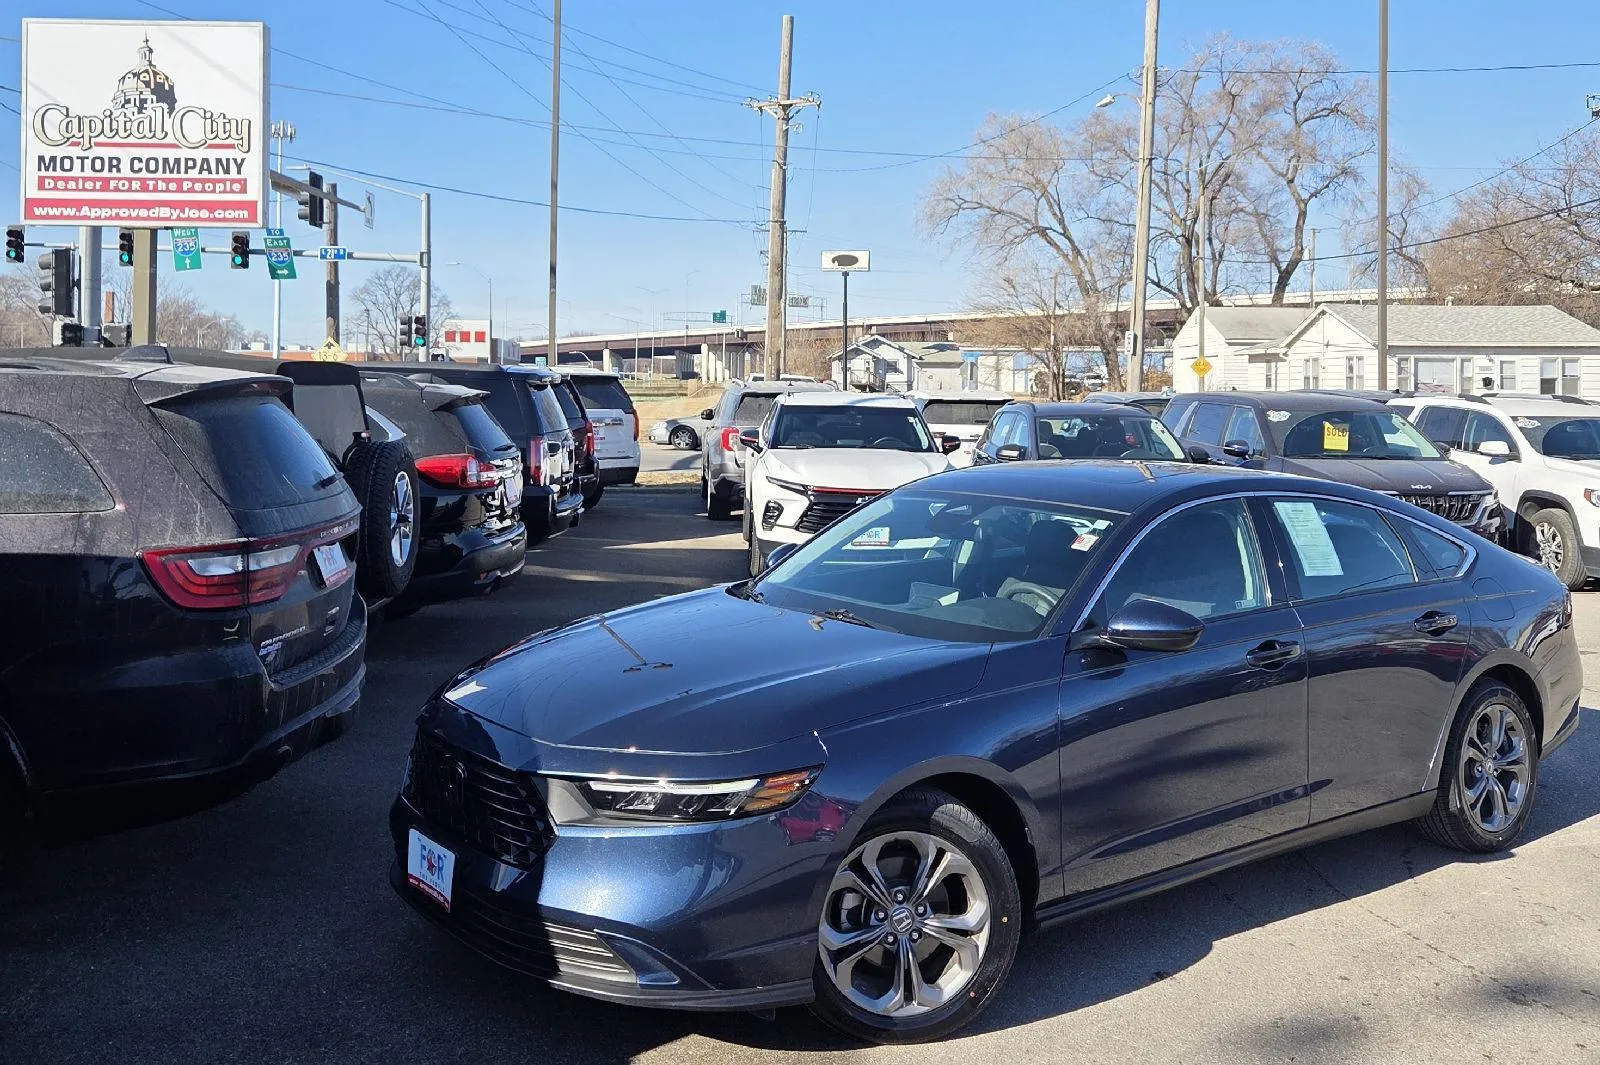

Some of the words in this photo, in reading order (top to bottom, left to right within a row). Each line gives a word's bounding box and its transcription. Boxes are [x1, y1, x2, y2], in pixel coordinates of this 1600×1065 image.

[33, 103, 168, 150] Capital
[172, 106, 251, 153] City
[37, 155, 122, 174] MOTOR
[129, 156, 246, 175] COMPANY
[44, 178, 102, 191] Dealer
[109, 179, 141, 191] FOR
[146, 180, 177, 192] The
[33, 205, 249, 220] www.ApprovedByJoe.com
[173, 228, 196, 237] WEST
[177, 241, 196, 252] 235
[266, 239, 288, 247] EAST
[271, 252, 289, 261] 235
[1326, 426, 1347, 437] SOLD
